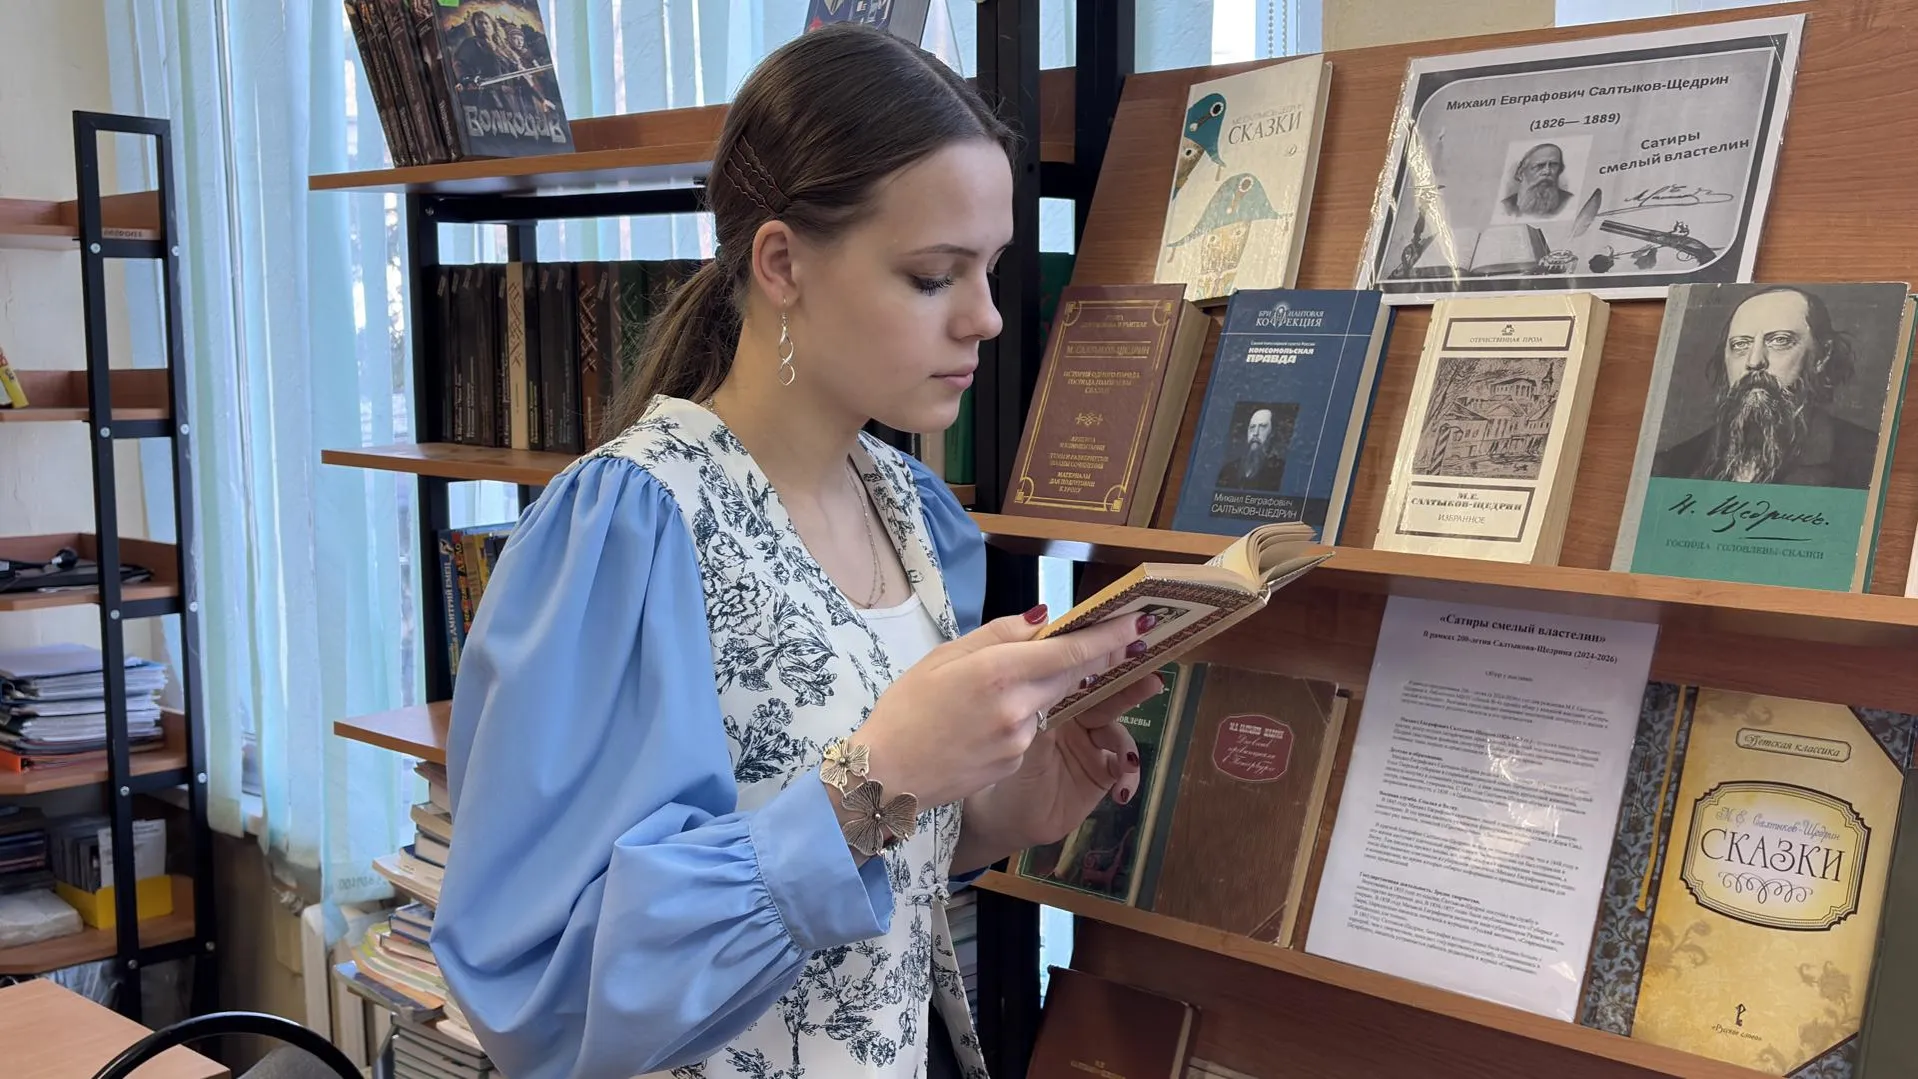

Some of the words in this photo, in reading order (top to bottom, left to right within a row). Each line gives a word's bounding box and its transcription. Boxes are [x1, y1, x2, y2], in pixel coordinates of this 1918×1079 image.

[1446, 98, 1496, 110] Михаил
[1500, 89, 1585, 106] Евграфович
[1588, 75, 1729, 97] Салтыков-Щедрин
[1228, 111, 1303, 145] СКАЗКИ
[1583, 112, 1621, 125] 1889)
[1640, 131, 1700, 150] Сатиры
[1598, 153, 1661, 175] смелый
[1664, 138, 1749, 162] властелин
[1246, 354, 1297, 365] ПРАВДА
[1248, 347, 1314, 355] КОМСОМОЛЬСКАЯ
[1214, 492, 1243, 502] Михаил
[1245, 495, 1293, 506] Евграфович
[1411, 498, 1522, 512] САЛТЫКОВ-ЩЕДРИН
[1211, 504, 1297, 519] САЛТЫКОВ-ЩЕДРИН
[1438, 513, 1486, 524] ИЗБРАННОЕ
[1665, 538, 1710, 550] ГОСПОДА
[443, 562, 454, 588] ЕМЕЦ
[446, 588, 458, 636] ДМИТРИЙ
[1439, 613, 1489, 628] «Сатиры
[1491, 619, 1535, 634] смелый
[1538, 625, 1606, 644] властелин»
[1429, 632, 1455, 641] рамках
[1456, 635, 1491, 646] 200-летия
[1493, 639, 1572, 657] Салтыкова-Щедрина
[1574, 650, 1618, 664] (2024-2026)
[1115, 714, 1151, 727] овлевы
[1744, 733, 1793, 749] Детская
[1795, 741, 1840, 757] классика
[1752, 812, 1840, 843] Салтыков-Щедрин
[1700, 828, 1845, 882] СКАЗКИ
